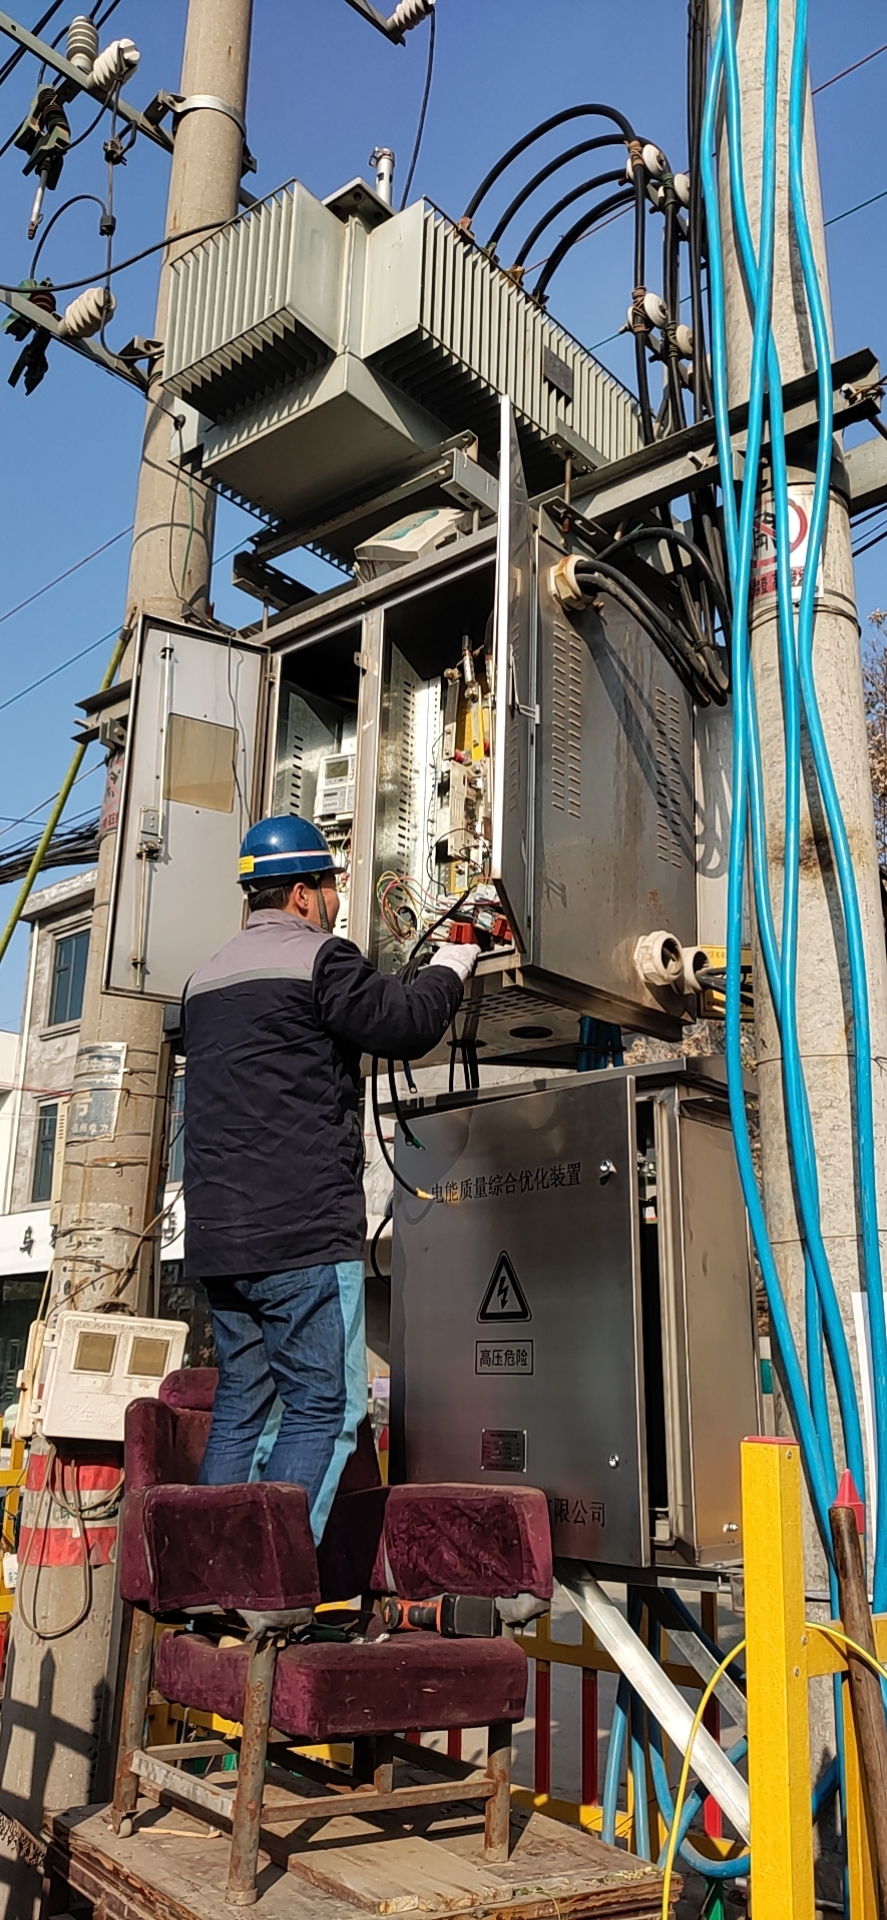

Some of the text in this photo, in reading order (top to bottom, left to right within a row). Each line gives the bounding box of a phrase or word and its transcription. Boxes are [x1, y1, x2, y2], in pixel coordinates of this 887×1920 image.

[431, 1162, 581, 1204] 电能质量综合优化装置
[480, 1348, 528, 1367] 高压危险
[547, 1498, 605, 1528] 限公司
